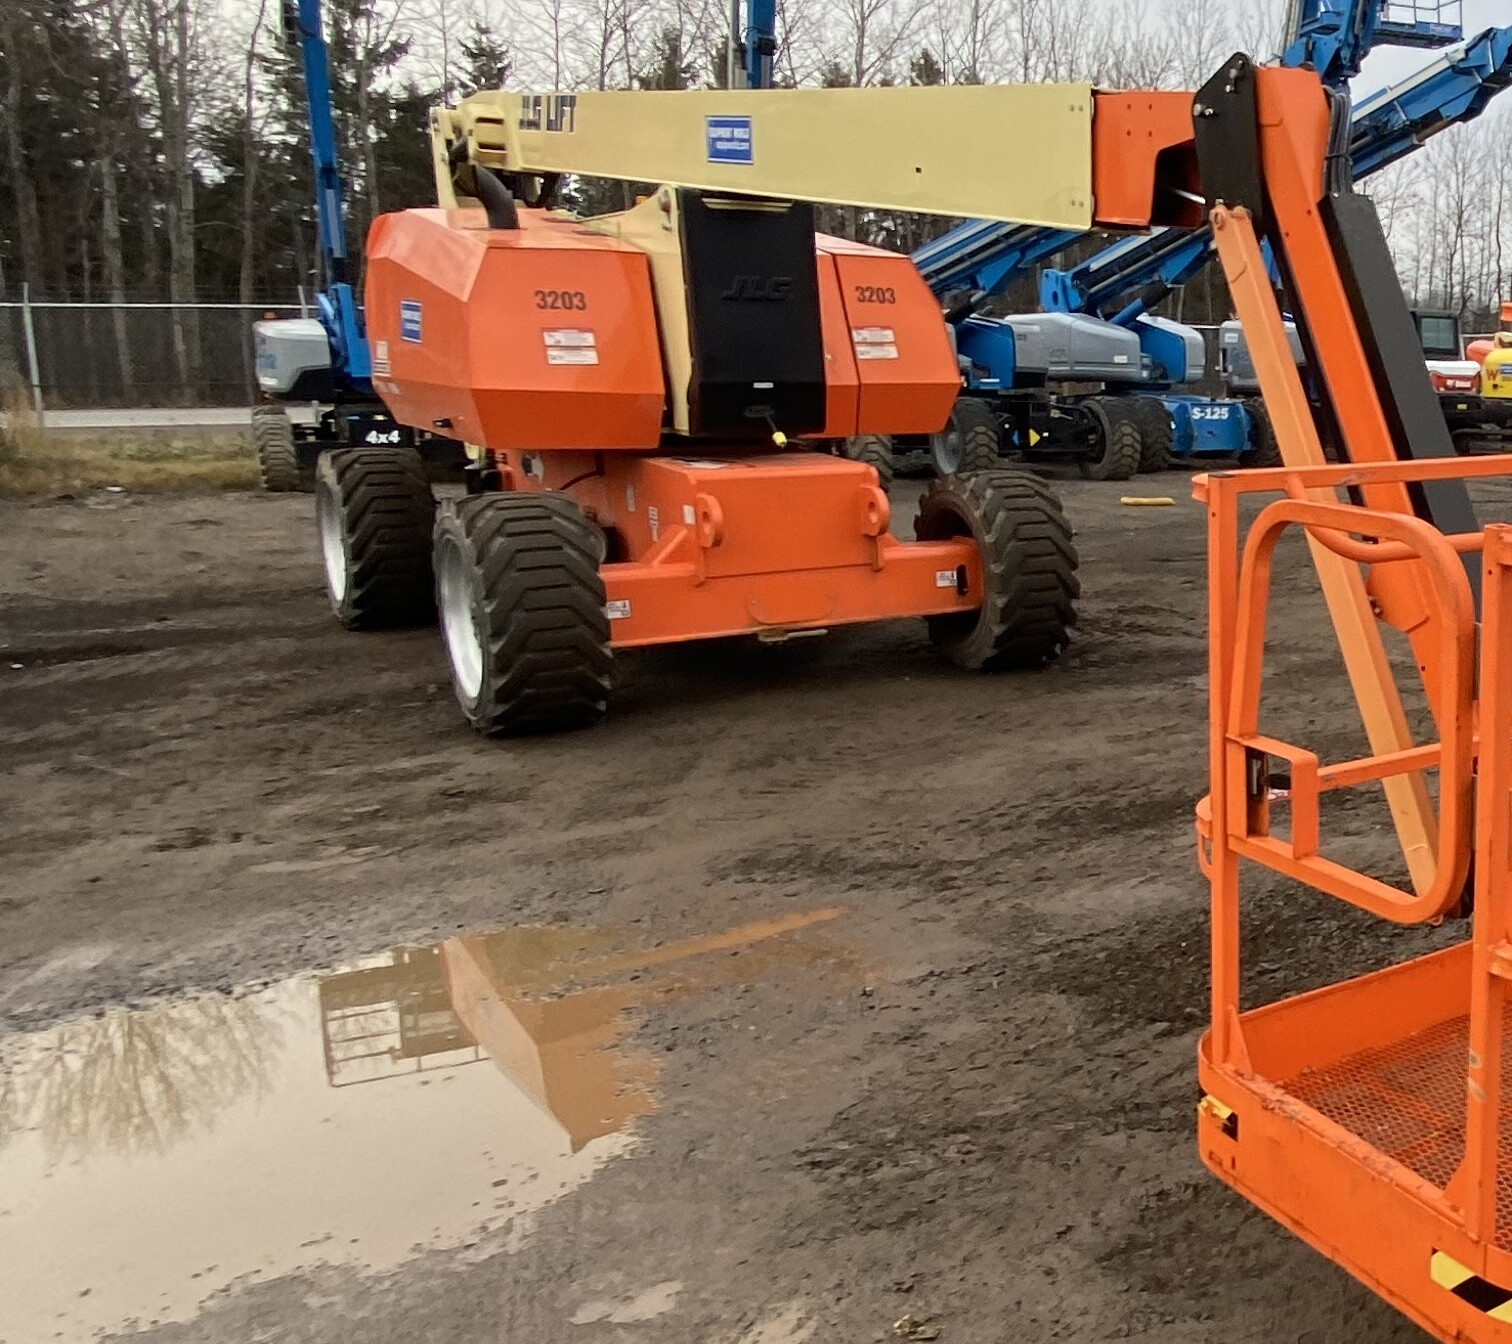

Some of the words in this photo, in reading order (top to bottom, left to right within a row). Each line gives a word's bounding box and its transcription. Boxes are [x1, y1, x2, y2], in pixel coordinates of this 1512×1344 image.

[546, 95, 577, 132] LIFT
[534, 290, 587, 311] 3203
[855, 286, 896, 304] 3203
[1192, 407, 1229, 420] S-125
[365, 430, 401, 444] 4x4
